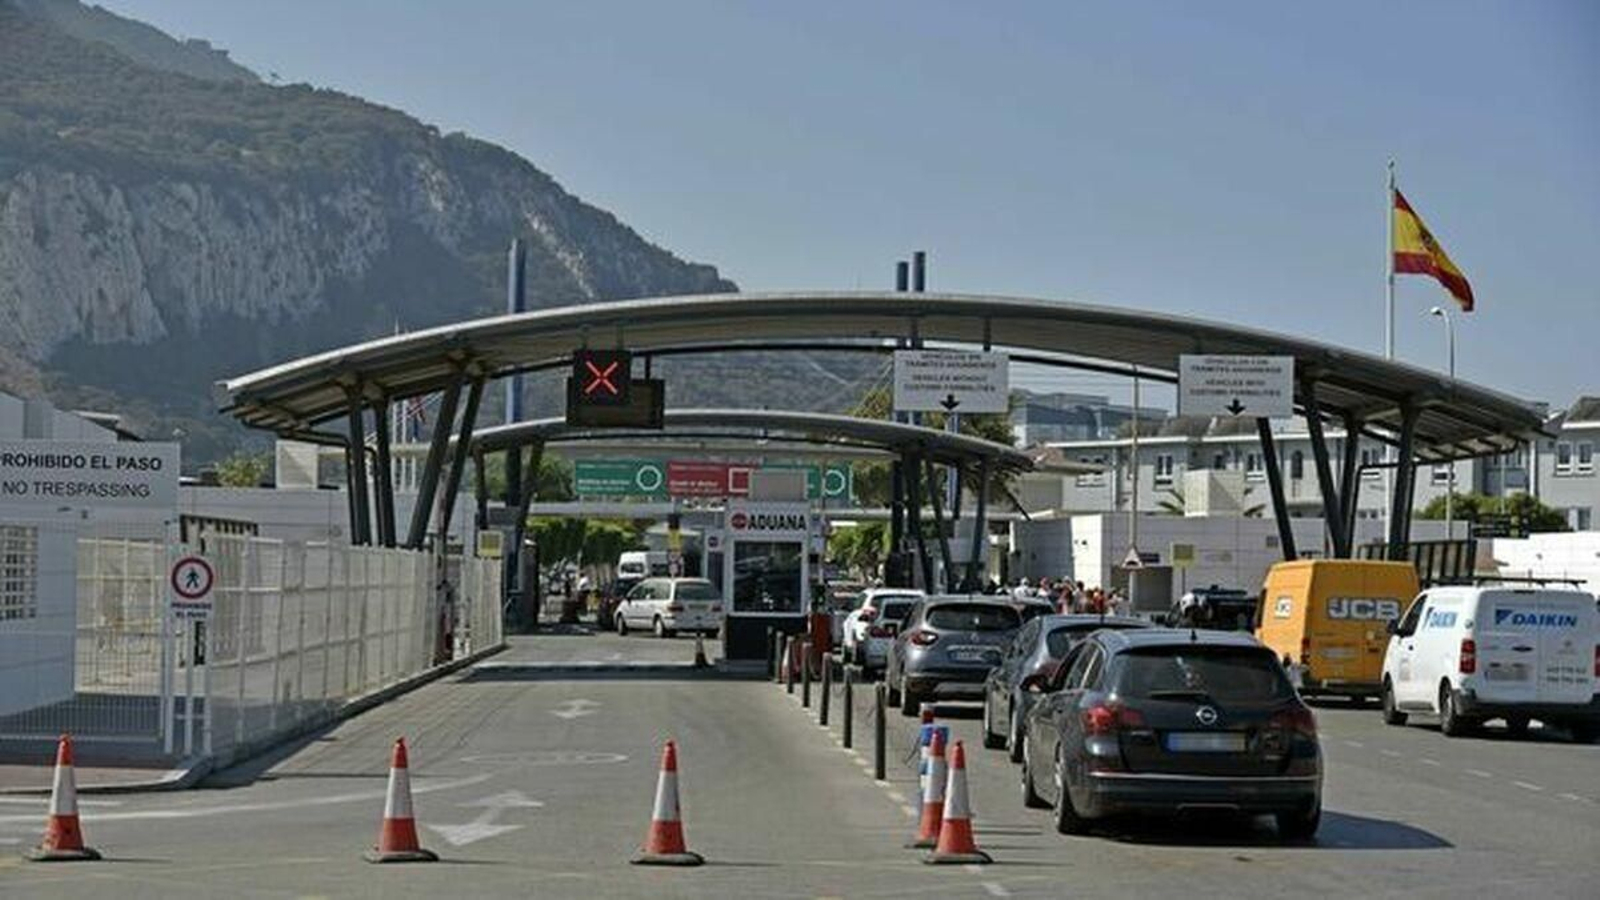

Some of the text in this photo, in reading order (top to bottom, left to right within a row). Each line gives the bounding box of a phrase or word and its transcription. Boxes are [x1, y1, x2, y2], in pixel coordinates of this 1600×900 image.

[0, 453, 162, 471] ROHIBIDO EL PASO
[3, 479, 150, 498] NO TRESPASSING
[747, 514, 807, 531] ADUANA
[1328, 598, 1400, 619] JCB
[1511, 612, 1579, 627] DAIKIN
